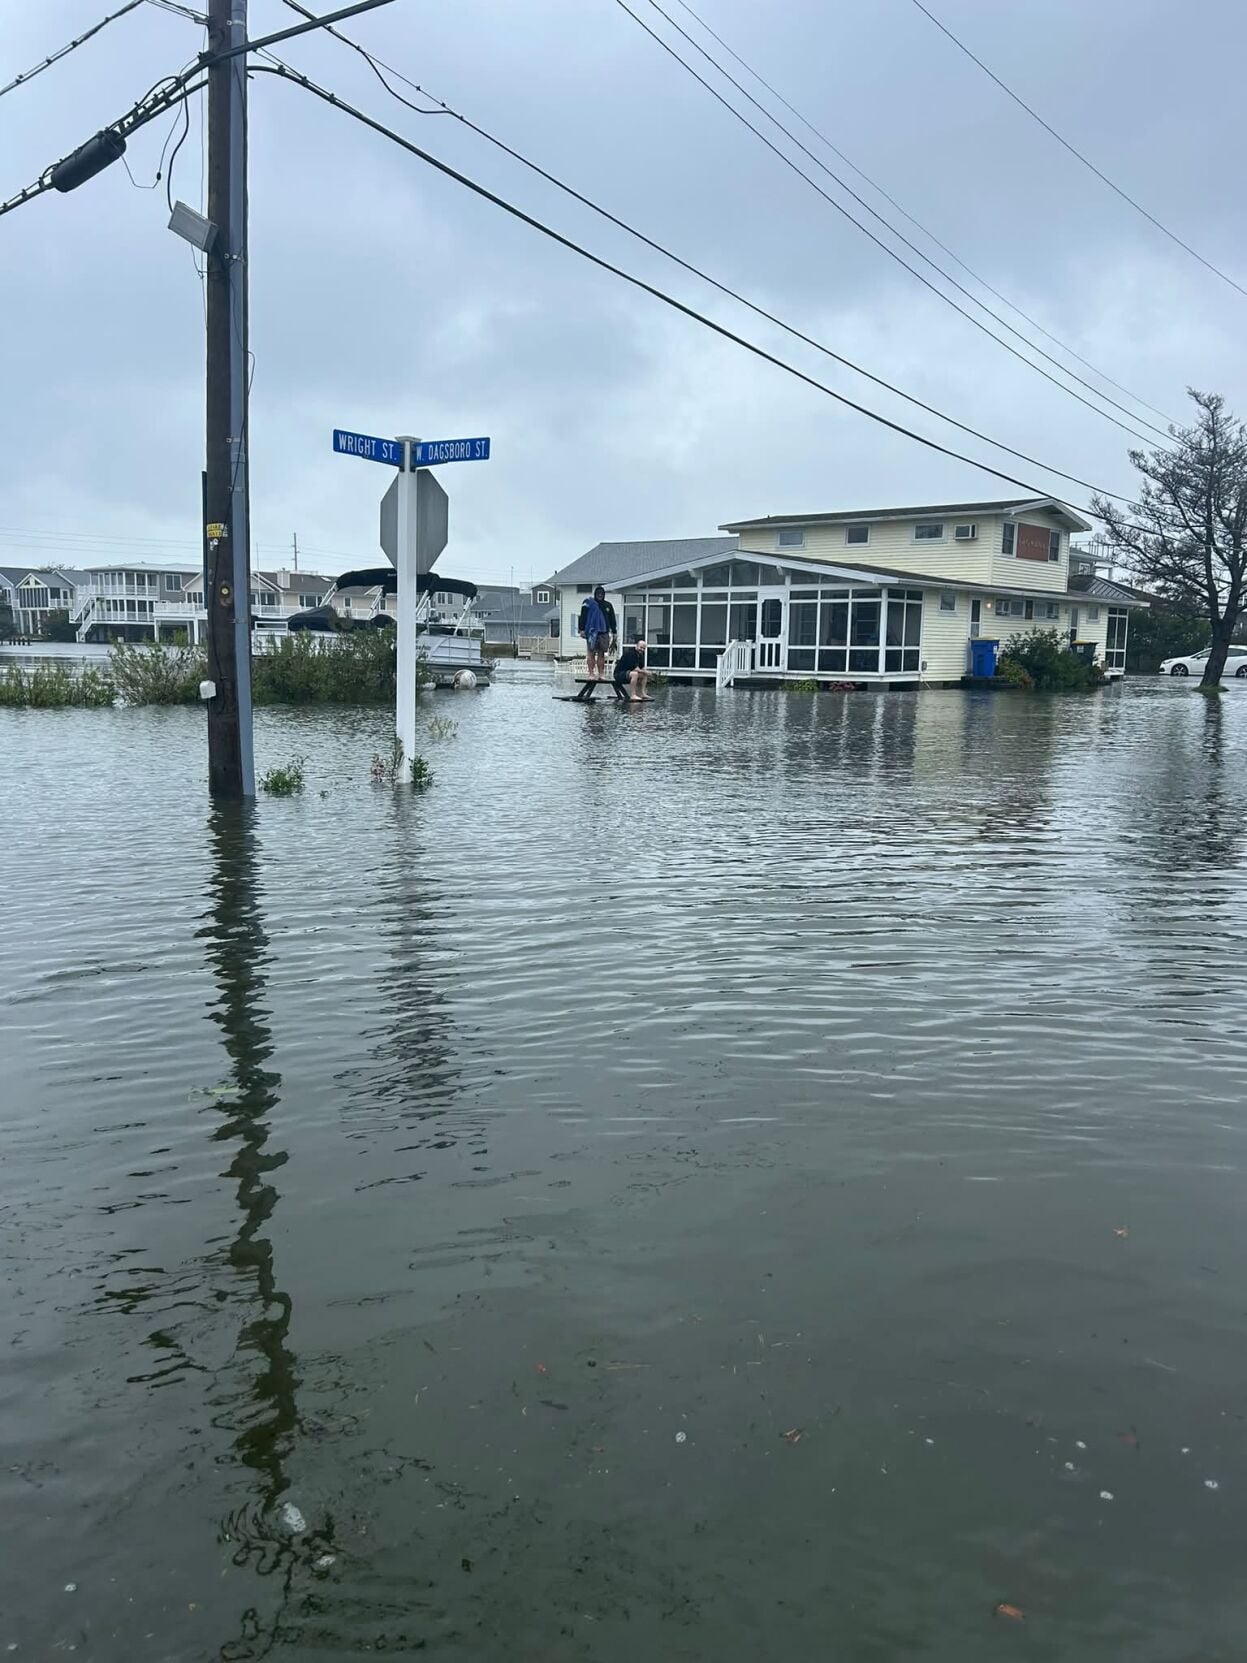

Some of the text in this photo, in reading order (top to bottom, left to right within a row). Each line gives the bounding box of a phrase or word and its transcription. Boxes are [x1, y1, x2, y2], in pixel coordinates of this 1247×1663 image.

[338, 433, 397, 460] WRIGHT ST.
[416, 440, 488, 461] W. DAGSBORO ST.
